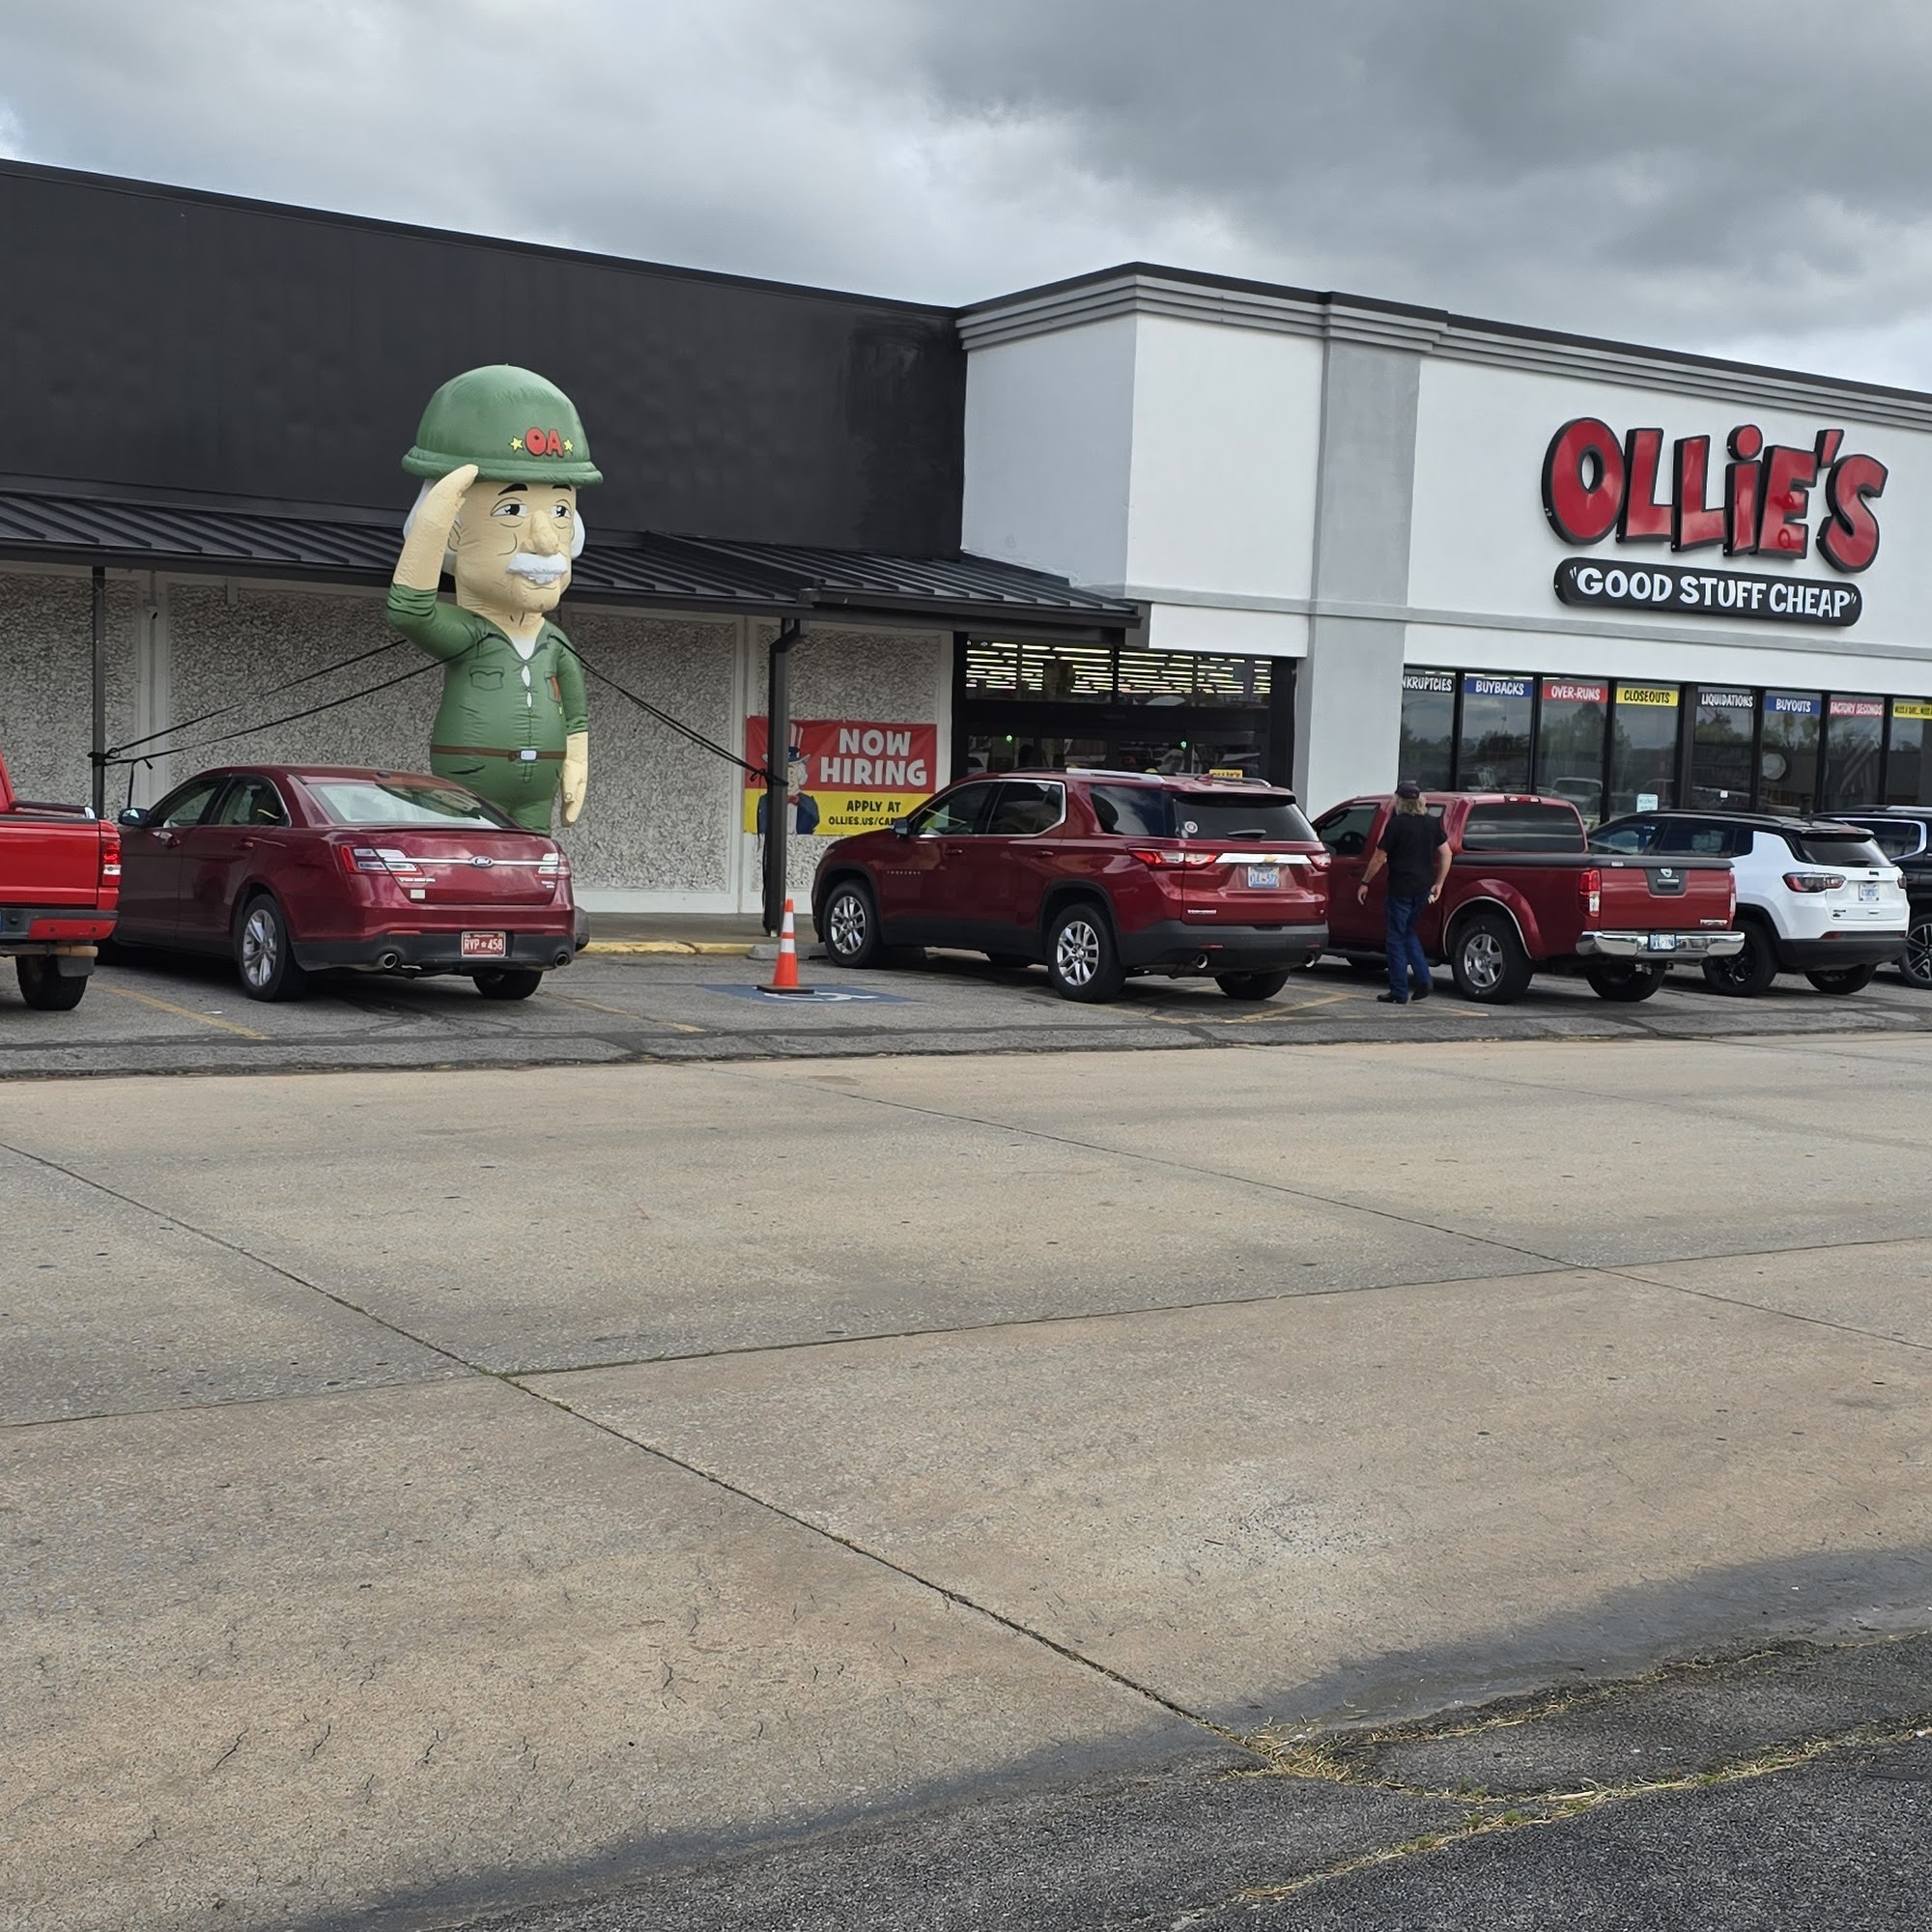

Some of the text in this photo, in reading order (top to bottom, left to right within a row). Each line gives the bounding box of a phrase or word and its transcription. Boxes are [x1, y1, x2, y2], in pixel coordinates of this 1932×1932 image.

[525, 426, 564, 459] OA
[1569, 566, 1858, 618] "GOOD STUFF CHEAP"
[1475, 680, 1524, 696] BUYBACKS
[1550, 685, 1601, 700] OVER-RUNS
[1624, 690, 1670, 703] CLOSEOUTS
[1700, 693, 1753, 708] LIQUIDATIONS
[1776, 698, 1811, 713] BUYOUTS
[838, 727, 911, 757] NOW
[820, 756, 927, 786] HIRING
[846, 800, 901, 812] APPLY AT
[464, 938, 503, 951] RVP 458
